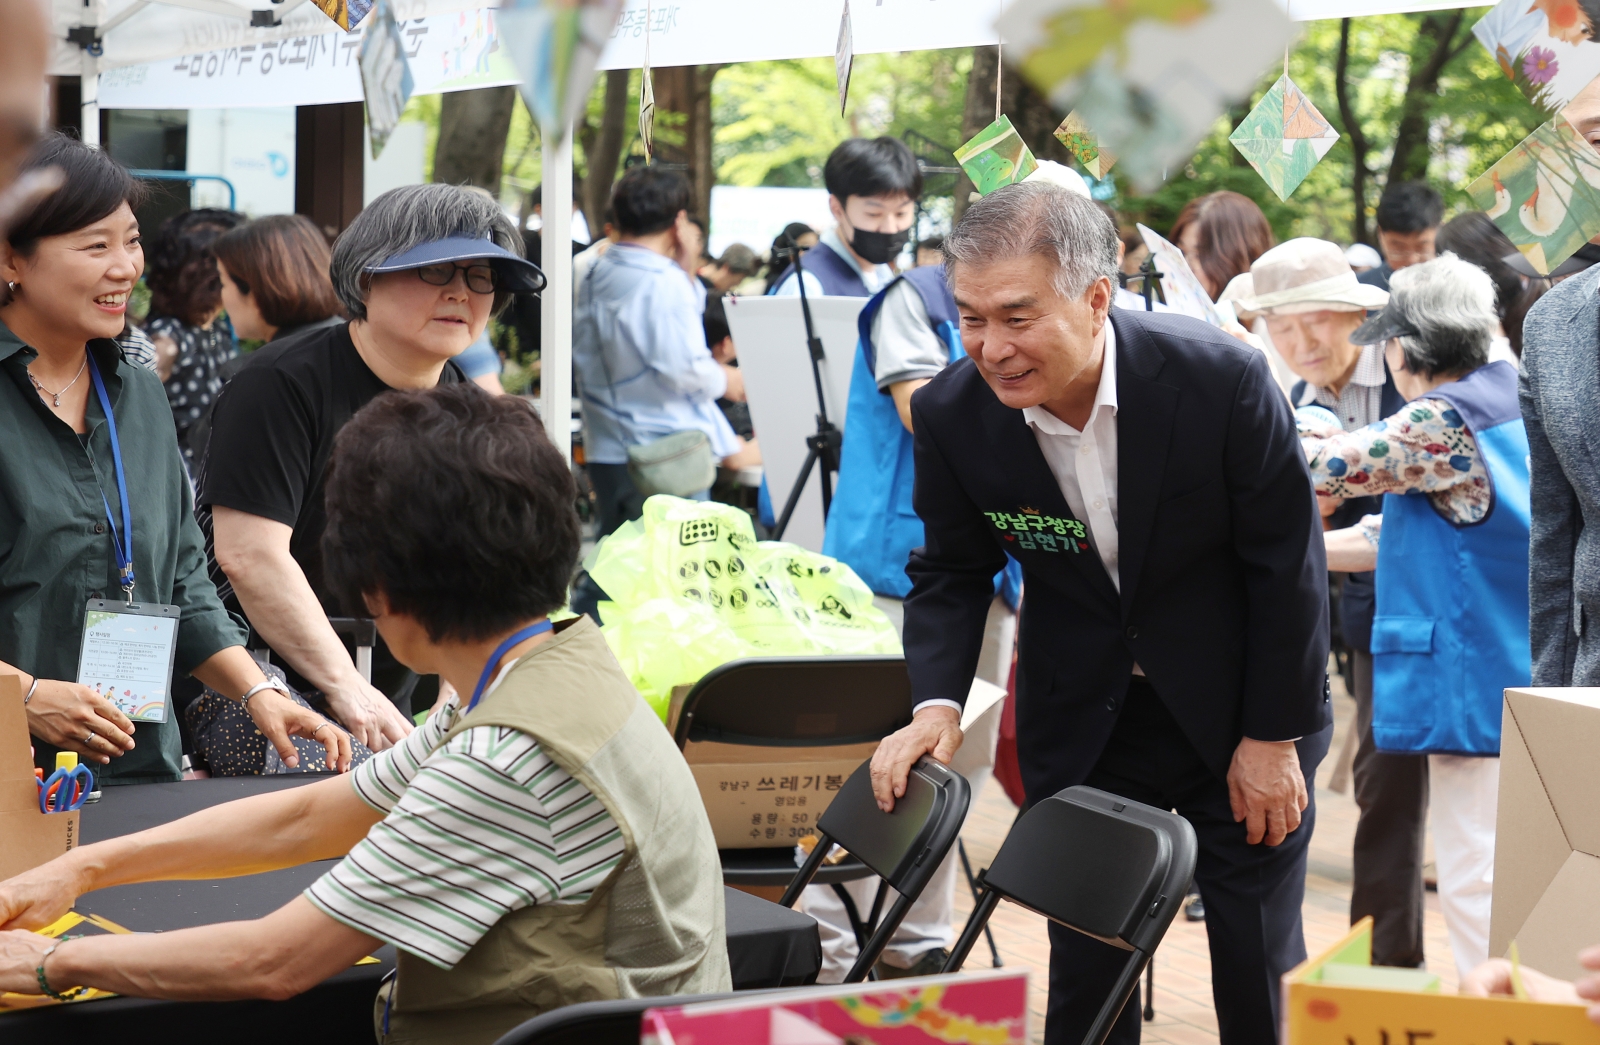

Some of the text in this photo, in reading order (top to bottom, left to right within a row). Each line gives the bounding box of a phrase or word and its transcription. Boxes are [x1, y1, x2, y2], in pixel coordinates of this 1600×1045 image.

[983, 511, 1087, 538] 강남구청장
[1010, 531, 1080, 554] 김현기
[719, 774, 852, 791] 강남구 쓰레기봉
[792, 813, 808, 824] 50
[789, 827, 815, 838] 300
